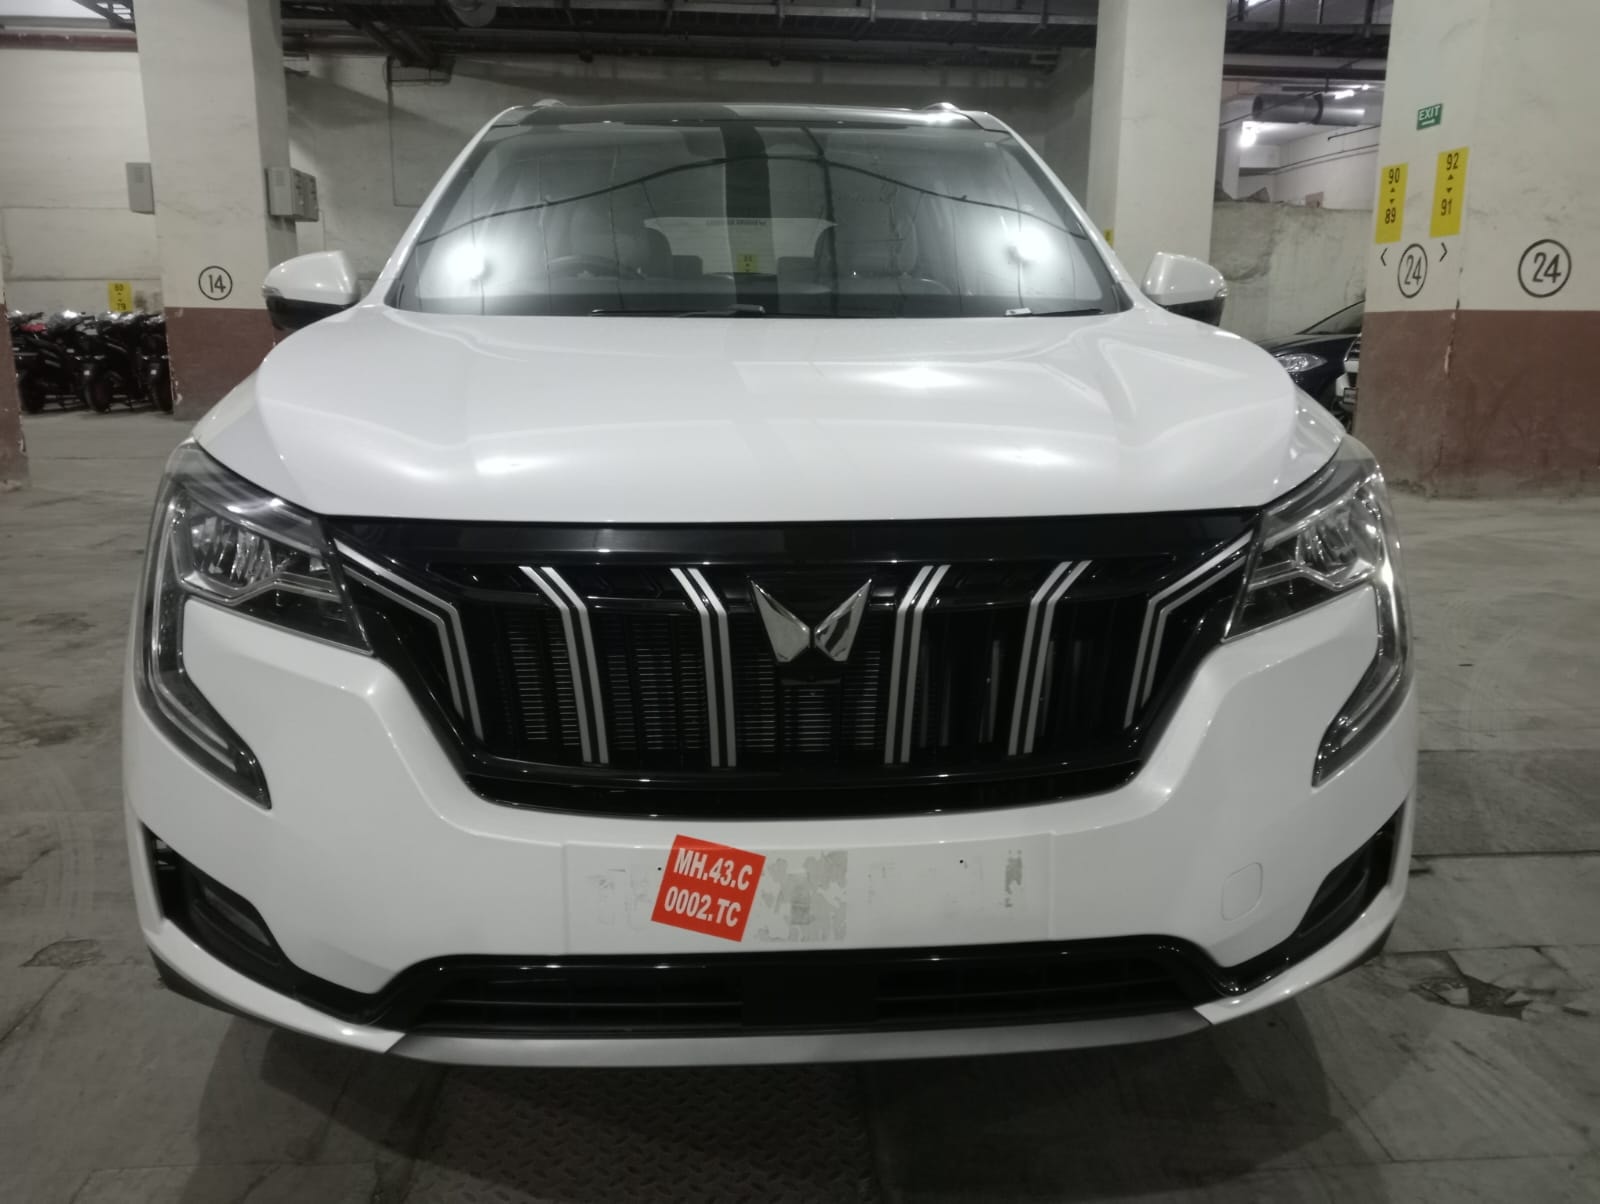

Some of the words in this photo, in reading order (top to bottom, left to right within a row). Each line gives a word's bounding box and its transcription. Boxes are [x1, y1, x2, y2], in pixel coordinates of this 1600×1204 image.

[1418, 104, 1441, 121] EXIT
[1446, 152, 1459, 170] 92
[1388, 167, 1400, 184] 90
[1385, 207, 1396, 224] 89
[1441, 198, 1452, 216] 91
[1404, 254, 1422, 285] 24
[1531, 252, 1561, 283] 24
[208, 274, 226, 293] 14
[673, 847, 753, 891] MH.43.C
[664, 886, 742, 927] 0002.TC
